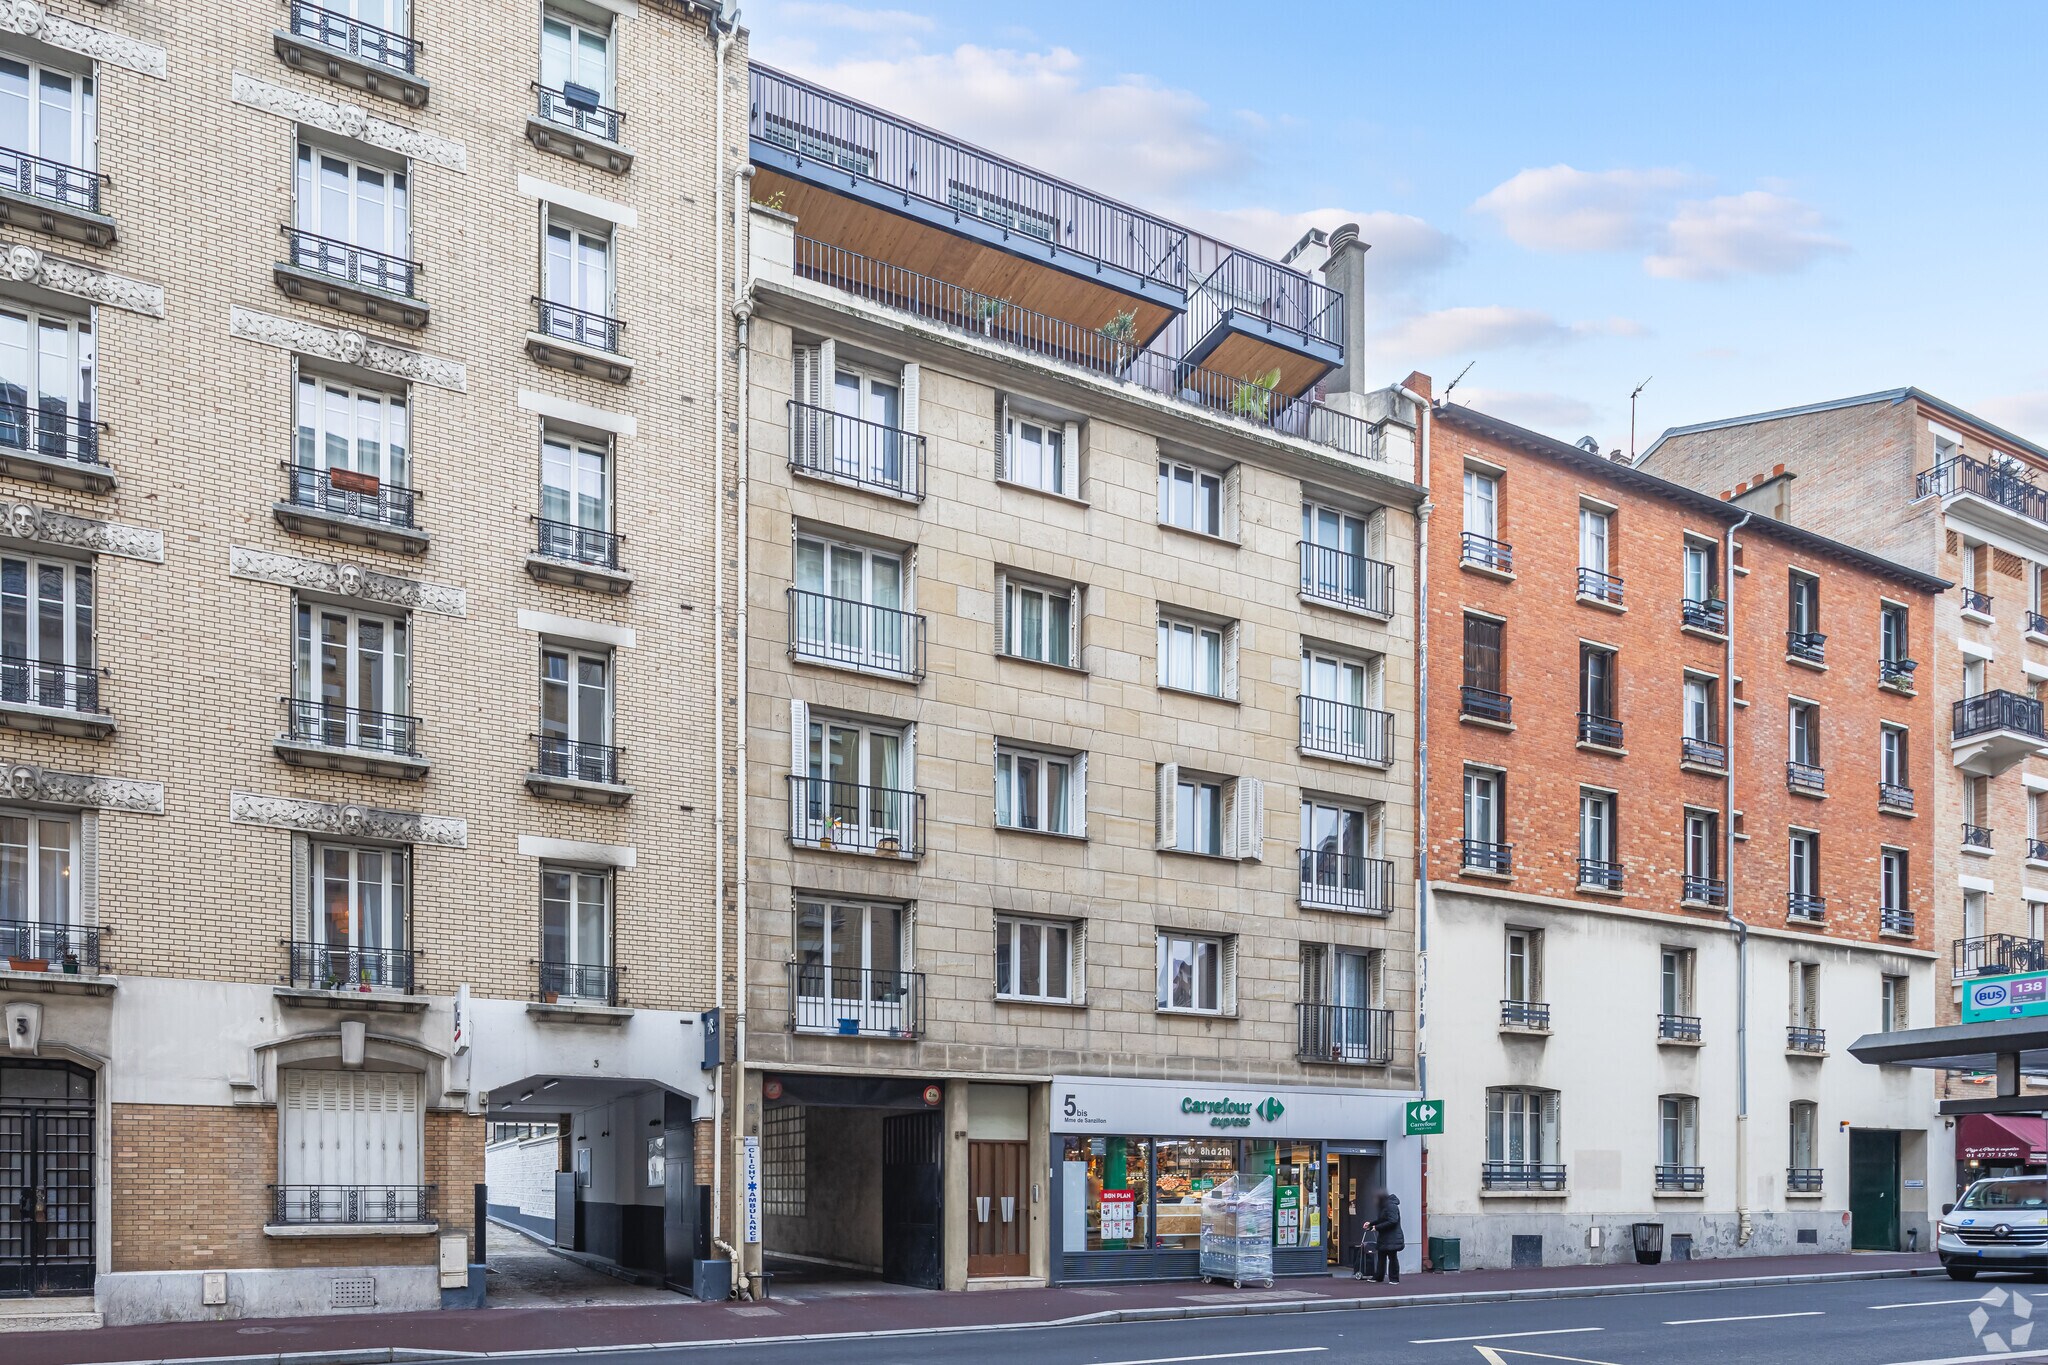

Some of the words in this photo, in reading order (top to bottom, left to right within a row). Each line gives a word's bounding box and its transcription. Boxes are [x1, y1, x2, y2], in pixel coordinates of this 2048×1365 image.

[2015, 982, 2043, 993] 138
[1979, 991, 2002, 1001] BUS
[17, 1018, 28, 1035] 3
[593, 1059, 600, 1069] 3
[1063, 1094, 1077, 1117] 5
[1076, 1109, 1088, 1117] bis
[1181, 1097, 1252, 1115] Carrefour
[1210, 1116, 1251, 1129] express
[1200, 1146, 1210, 1156] 8h
[1217, 1147, 1230, 1156] 21h
[748, 1147, 756, 1181] CLICHY
[748, 1192, 757, 1242] AMBULANCE
